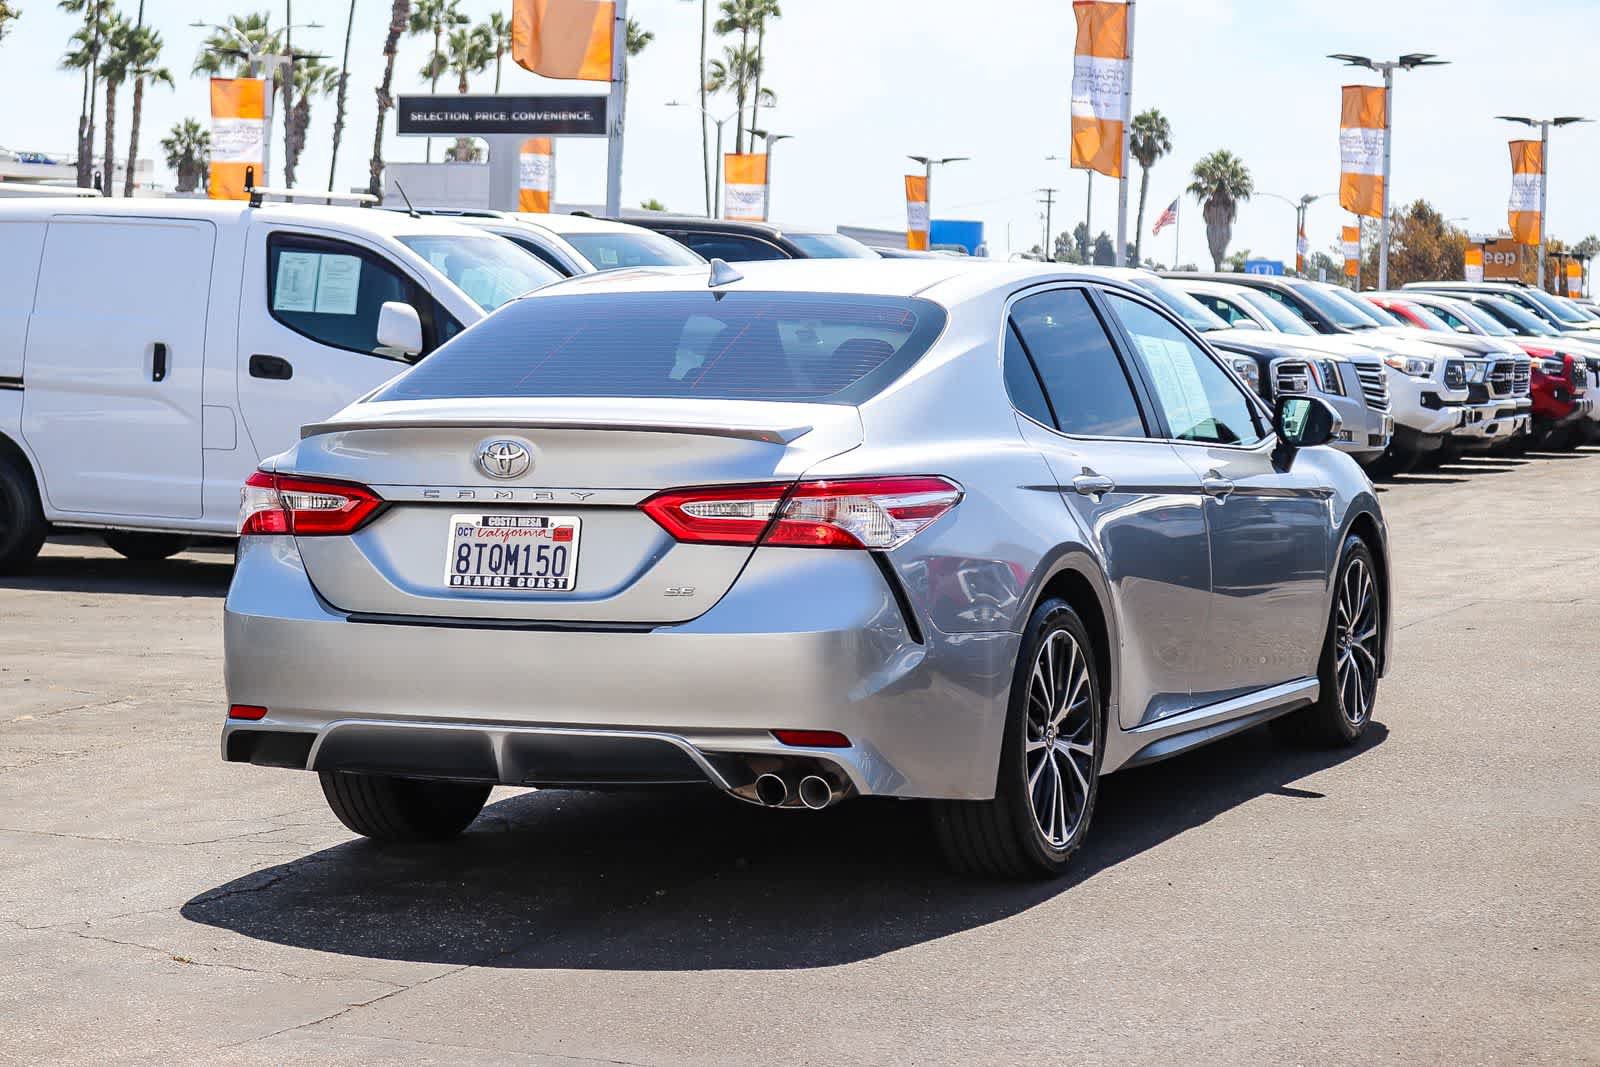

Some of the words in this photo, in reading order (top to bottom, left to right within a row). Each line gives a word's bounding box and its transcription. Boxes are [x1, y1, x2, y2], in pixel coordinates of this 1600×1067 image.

[410, 111, 472, 121] SELECTION.
[475, 111, 510, 121] PRICE.
[512, 111, 594, 121] CONVENIENCE.
[1485, 251, 1517, 267] eep
[423, 489, 596, 501] CAMRY
[488, 517, 516, 527] COSTA
[457, 527, 474, 537] OCT
[477, 527, 549, 543] California
[455, 543, 567, 577] 8TQM150
[453, 575, 511, 587] ORANGE
[517, 577, 566, 588] COAST
[663, 586, 697, 597] SE
